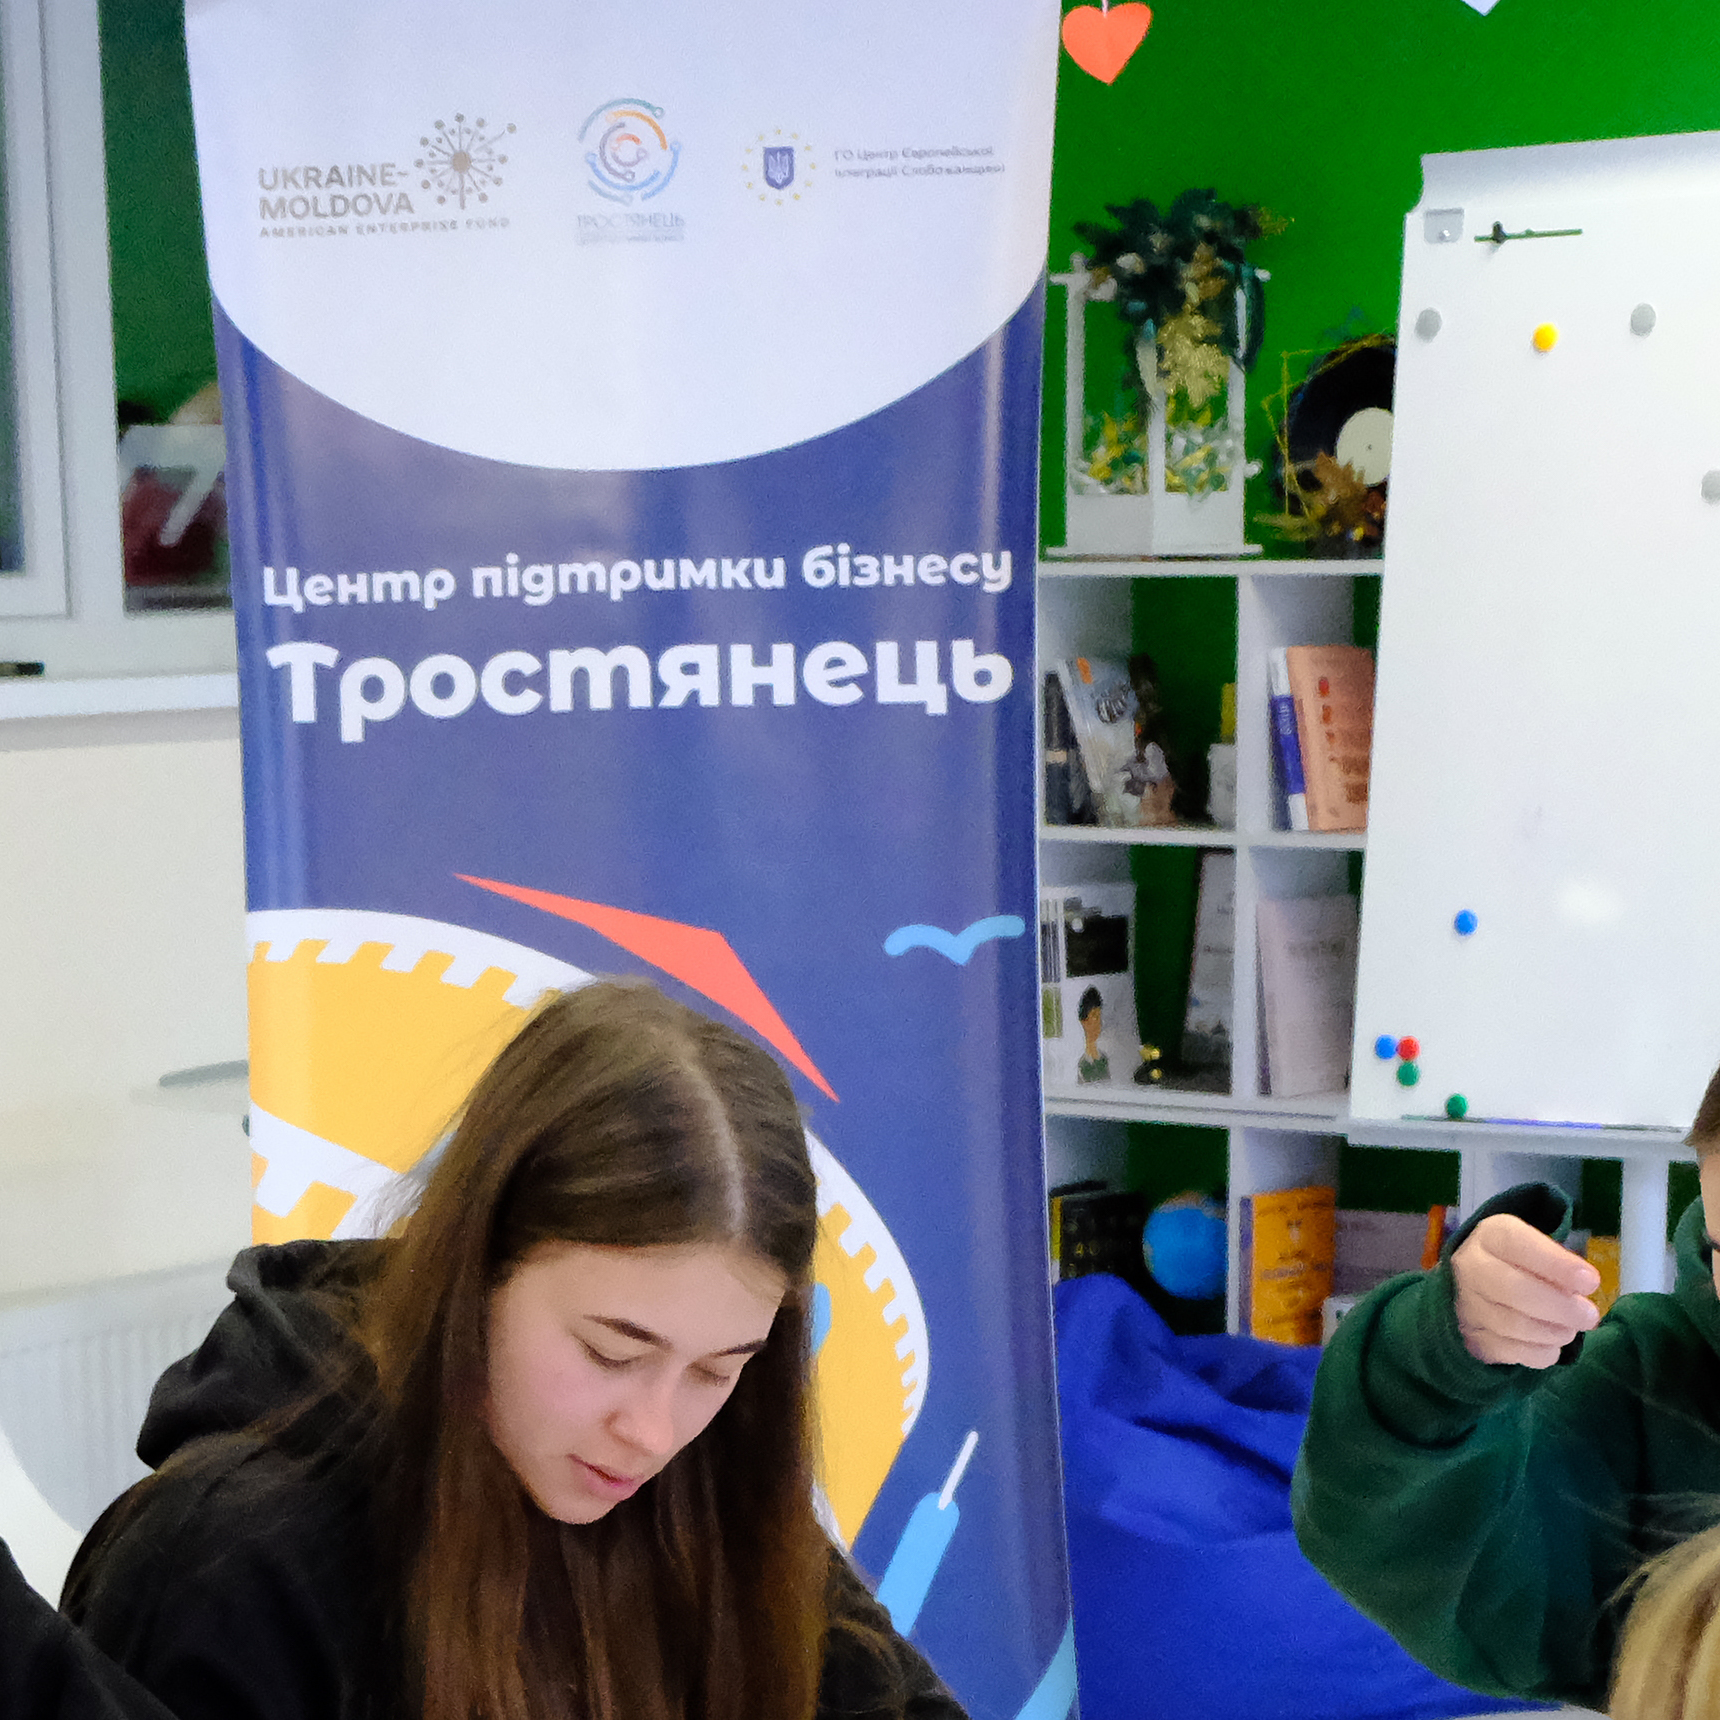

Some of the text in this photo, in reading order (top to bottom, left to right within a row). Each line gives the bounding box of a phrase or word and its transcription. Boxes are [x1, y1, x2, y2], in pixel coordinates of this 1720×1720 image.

[259, 192, 415, 220] MOLDOVA
[259, 226, 348, 238] AMERICAN
[356, 220, 458, 234] ENTERPRISE
[262, 543, 1014, 611] Центр підтримки бізнесу
[267, 638, 1015, 744] Тростянець
